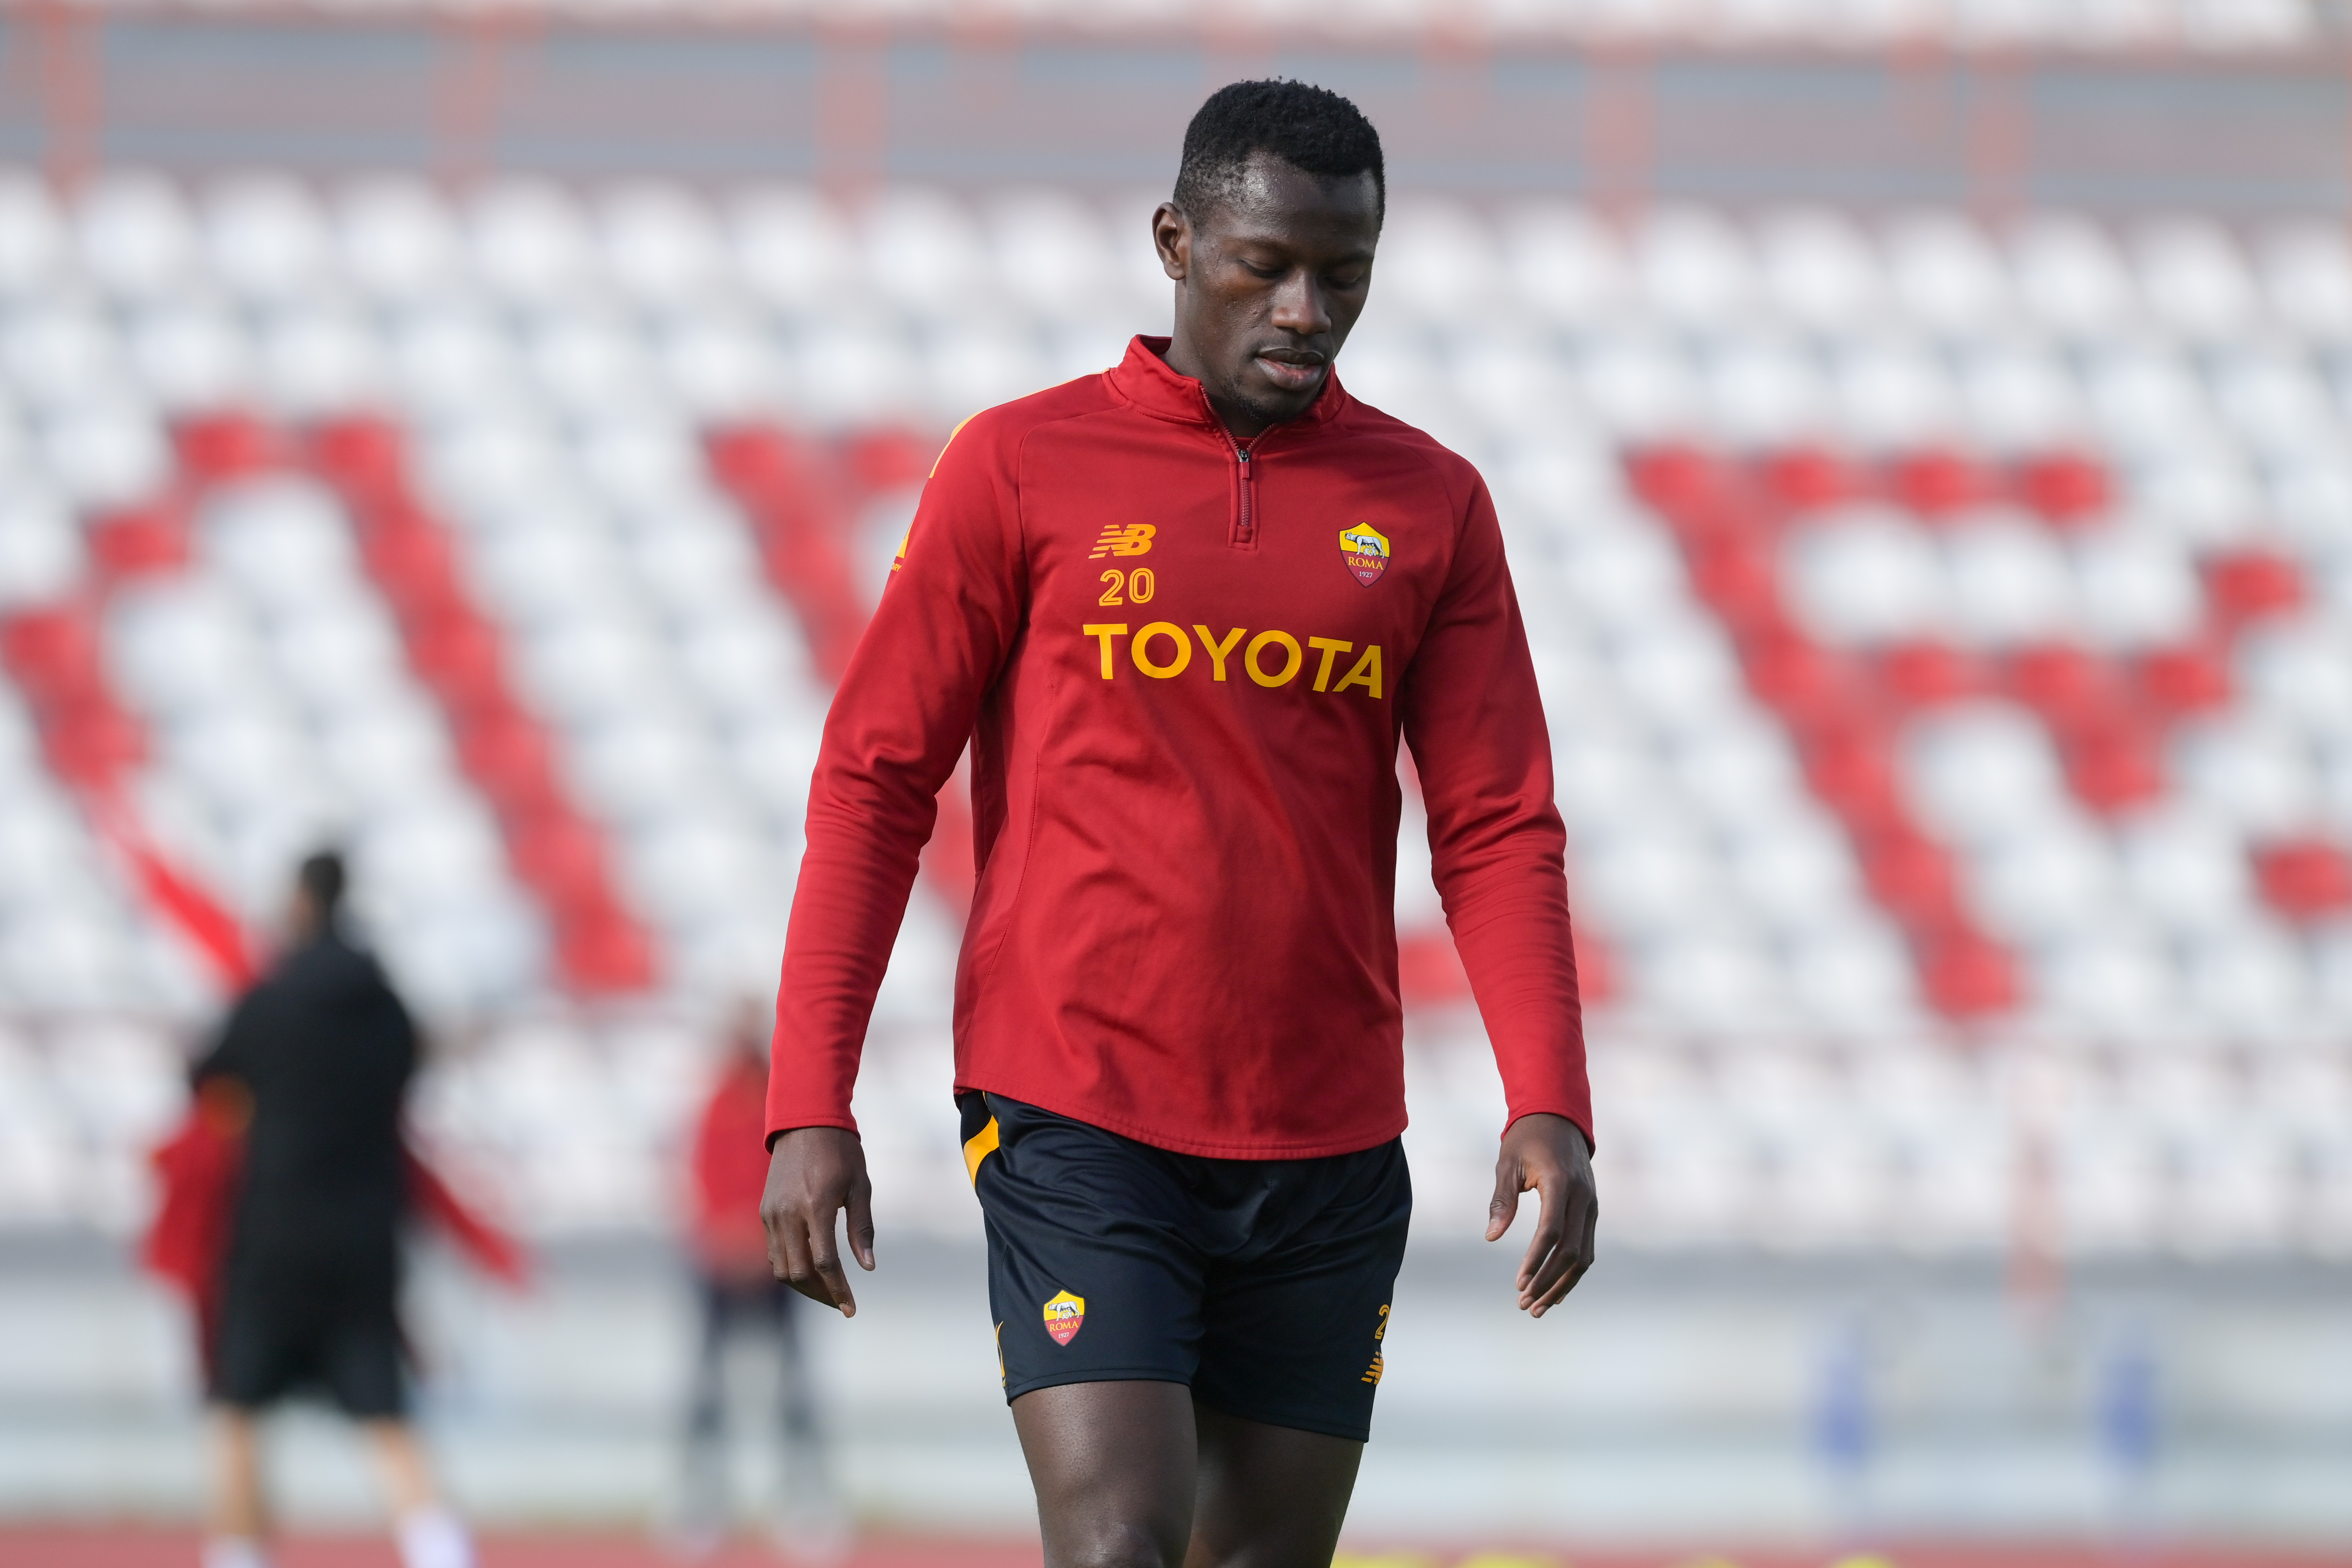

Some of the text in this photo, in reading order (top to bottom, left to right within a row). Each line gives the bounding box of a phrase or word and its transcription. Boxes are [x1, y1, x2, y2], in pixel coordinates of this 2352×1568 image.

[1348, 556, 1384, 570] ROMA
[1099, 567, 1154, 606] 20
[1083, 621, 1382, 699] TOYOTA
[1050, 1320, 1079, 1332] ROMA
